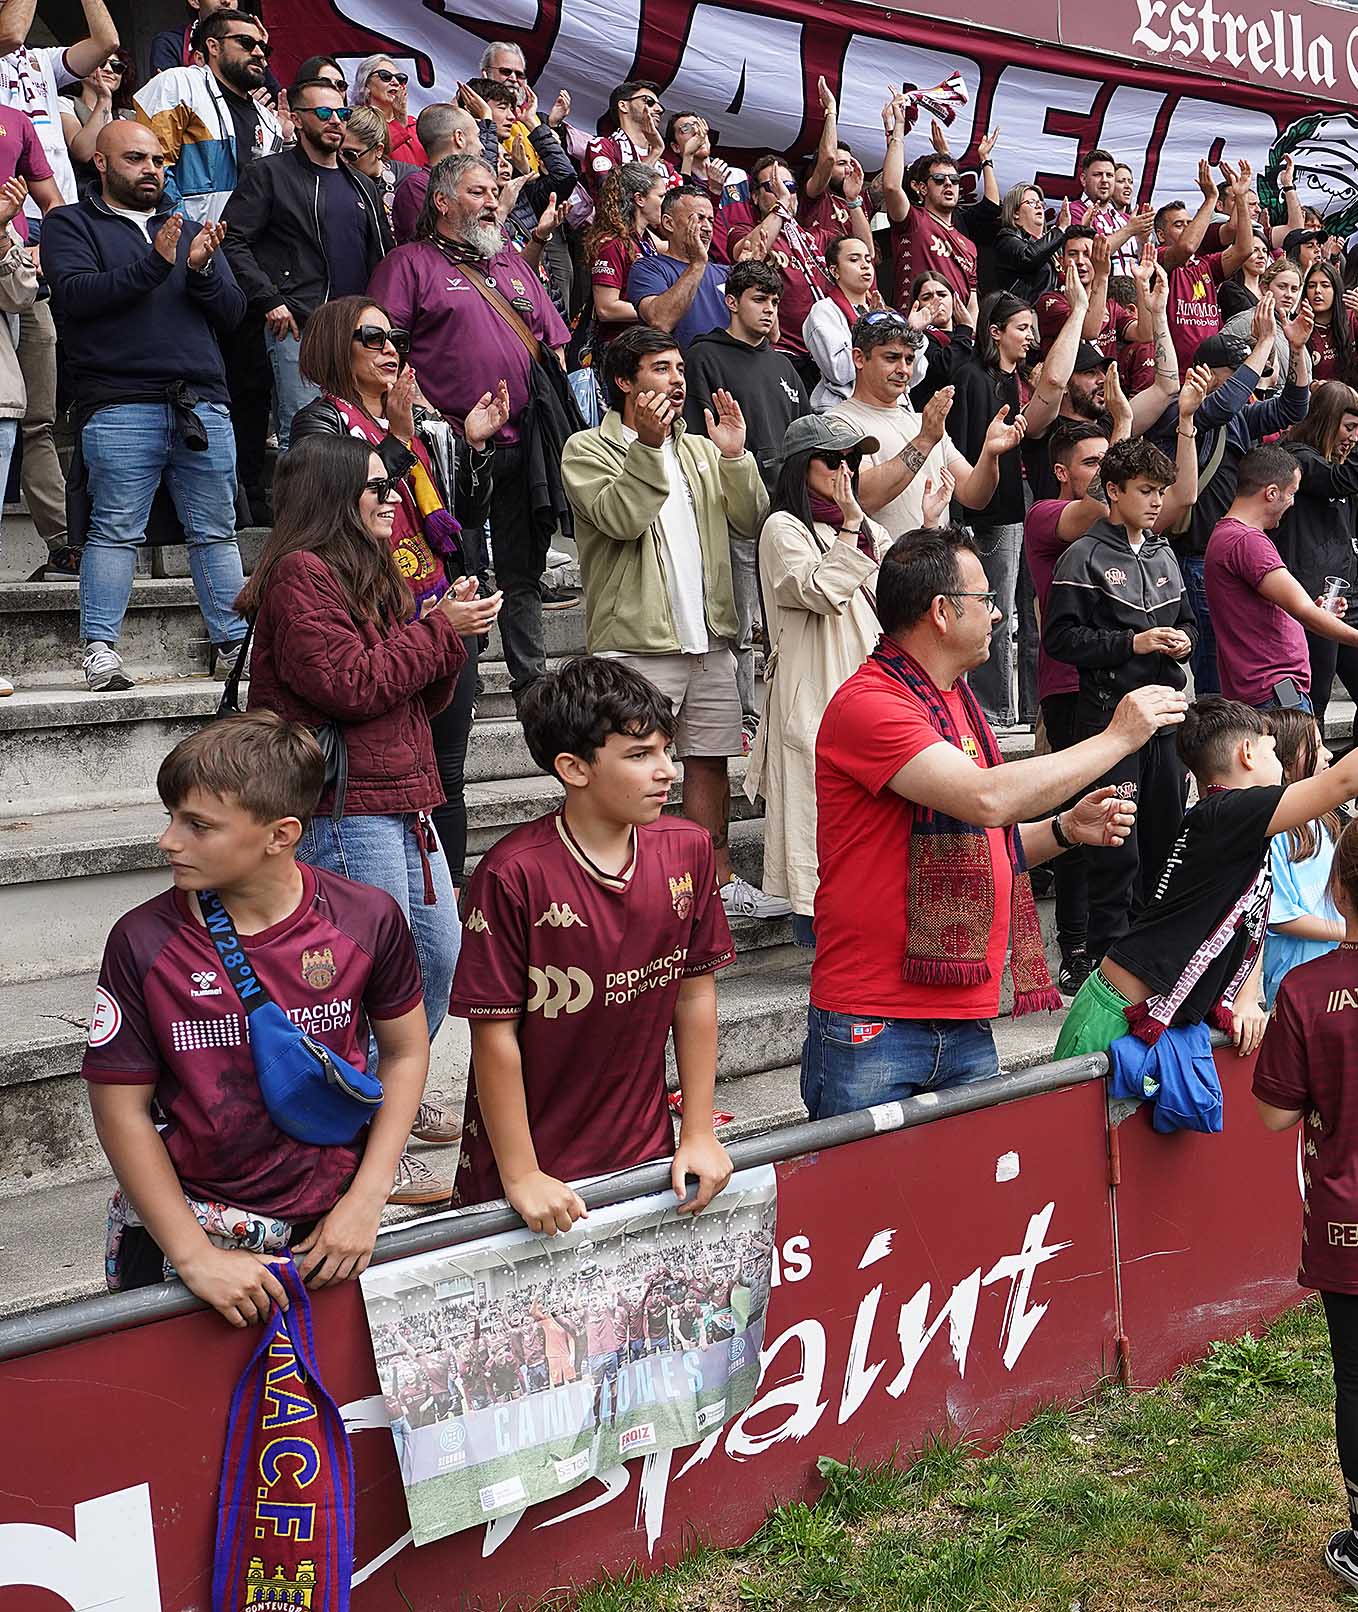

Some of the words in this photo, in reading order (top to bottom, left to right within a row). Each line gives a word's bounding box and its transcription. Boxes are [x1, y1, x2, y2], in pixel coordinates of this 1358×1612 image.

[1132, 0, 1337, 89] Estrella
[190, 986, 223, 998] hummel
[469, 1007, 490, 1016] NON
[621, 1427, 651, 1448] FROIZ
